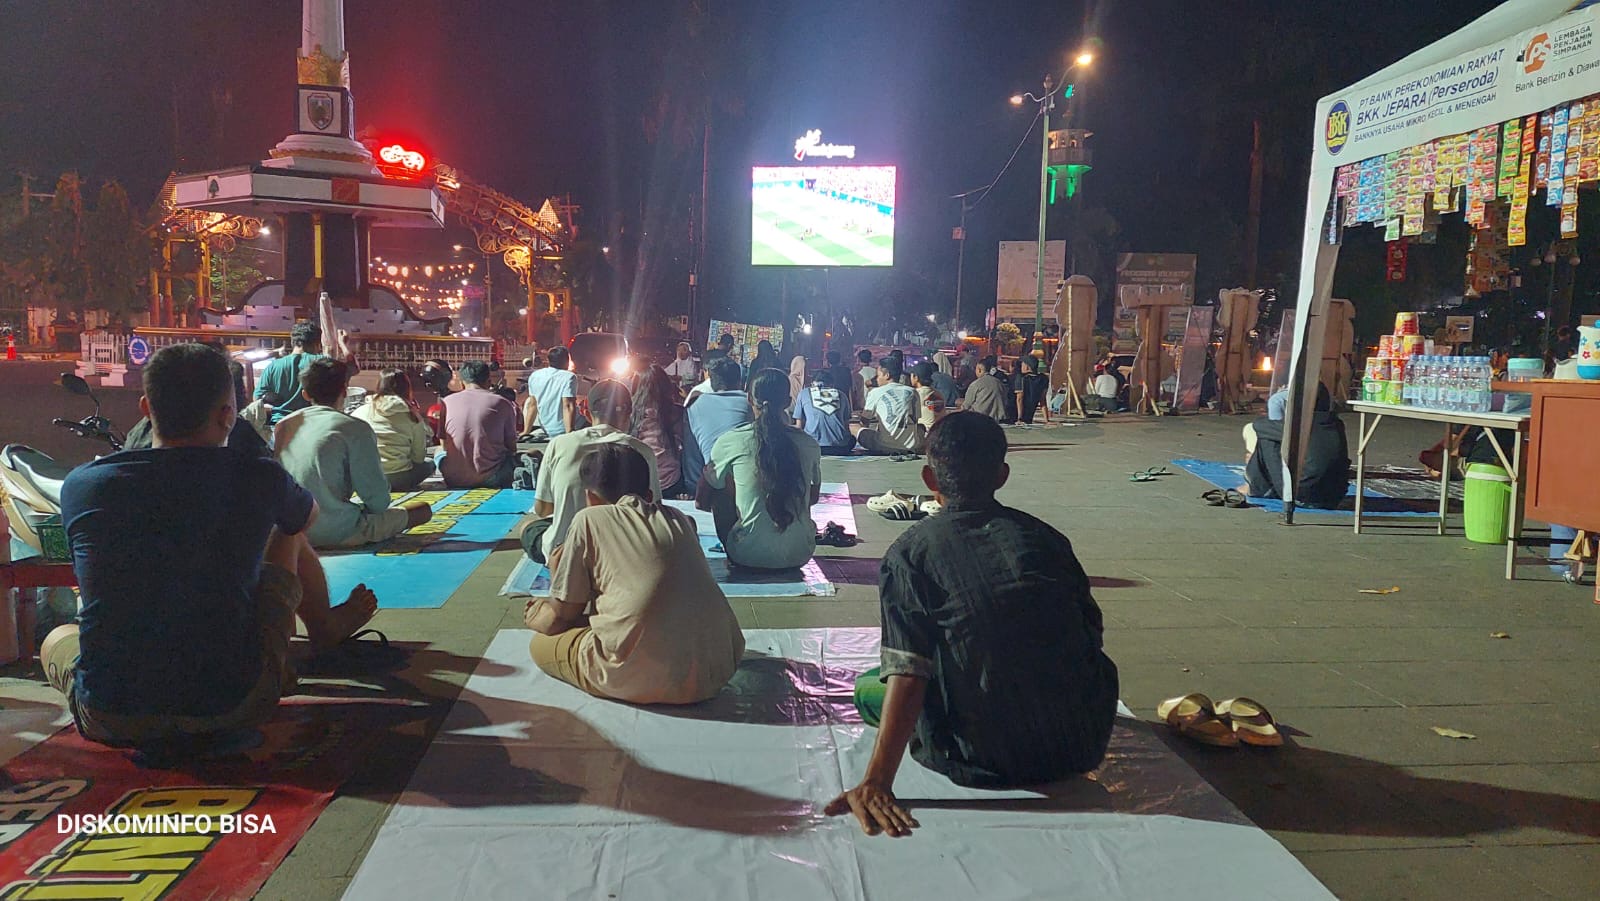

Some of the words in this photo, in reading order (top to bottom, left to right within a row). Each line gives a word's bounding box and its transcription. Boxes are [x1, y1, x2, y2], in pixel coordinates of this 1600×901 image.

[1553, 31, 1593, 49] PENJAMIN
[1554, 25, 1591, 42] LEMBAGA
[1553, 39, 1592, 57] SIMPANAN
[1370, 89, 1393, 105] BANK
[1395, 64, 1465, 98] PEREKONOMIAN
[1467, 48, 1505, 72] RAKYAT
[1515, 80, 1534, 93] Bank
[1568, 67, 1574, 77] &
[1357, 106, 1380, 125] BKK
[1382, 91, 1427, 118] JEPARA
[1428, 66, 1499, 106] (Perseroda)
[1354, 129, 1382, 143] BANKNYA
[1383, 122, 1405, 134] USAHA
[1406, 114, 1426, 128] MIKRO
[1427, 107, 1445, 120] KECIL
[1447, 105, 1453, 114] &
[1455, 92, 1497, 111] MENENGAH
